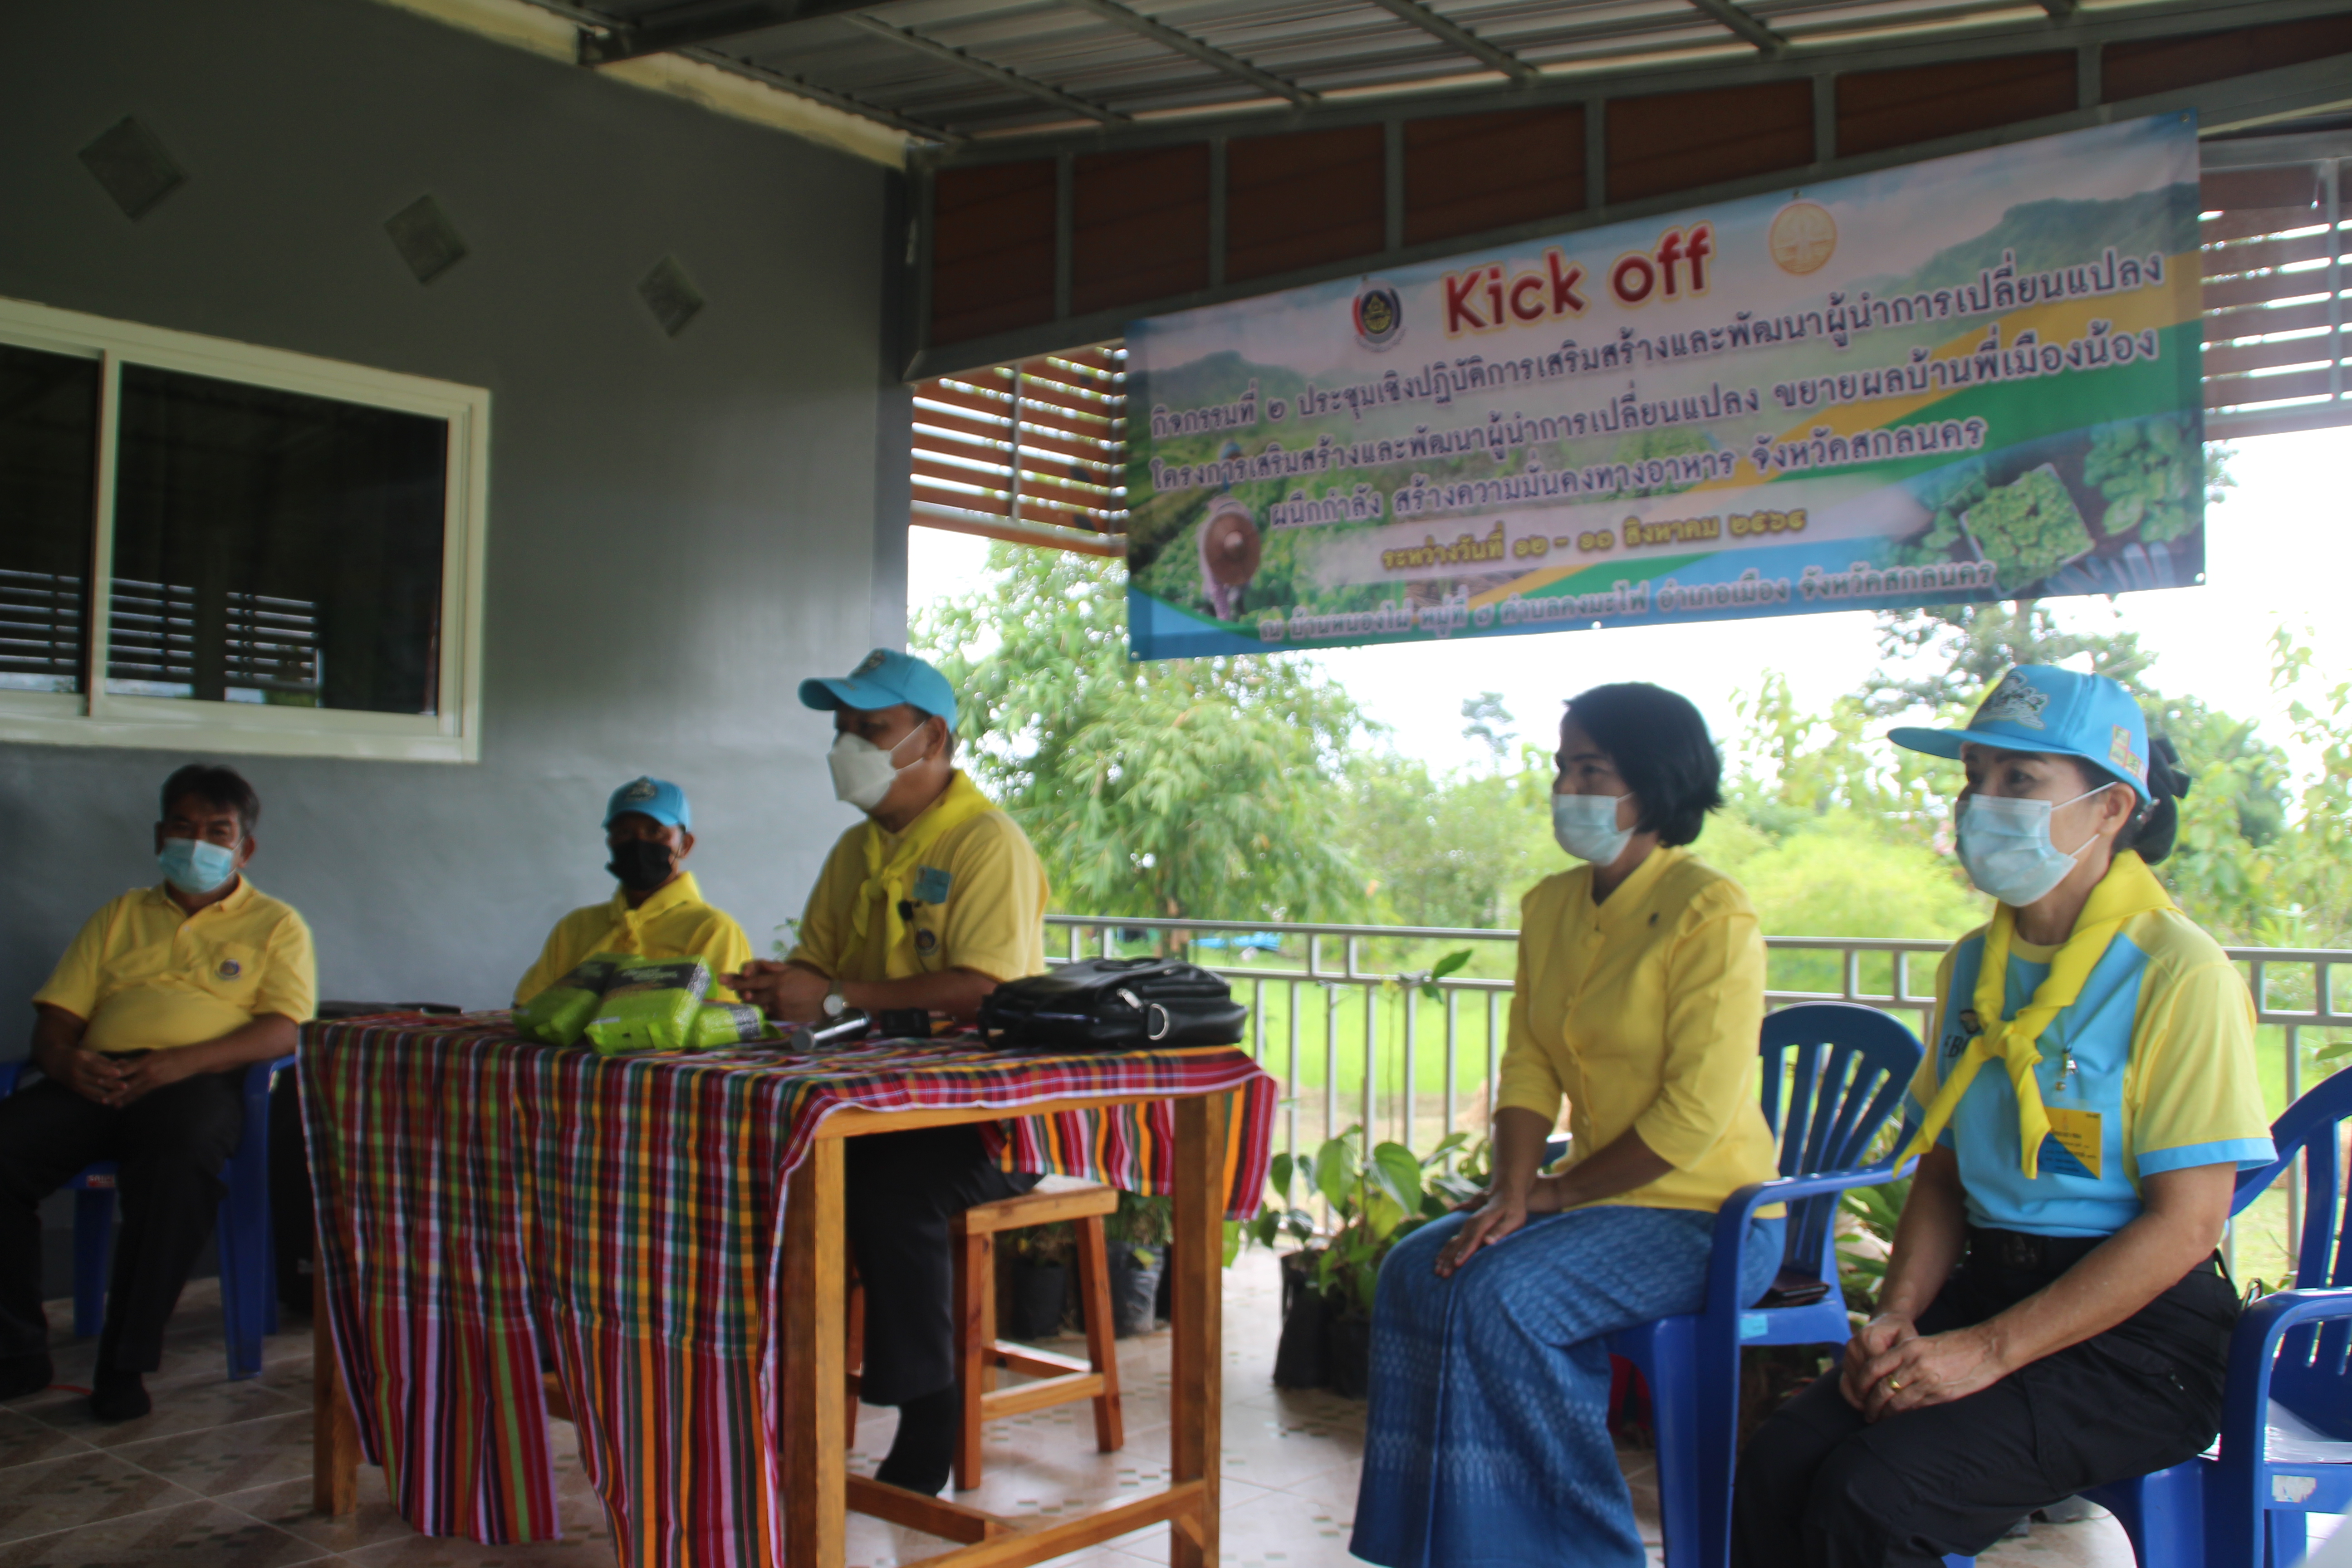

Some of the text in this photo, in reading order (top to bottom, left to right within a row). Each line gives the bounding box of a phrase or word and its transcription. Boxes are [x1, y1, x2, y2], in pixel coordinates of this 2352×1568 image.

[1446, 225, 1711, 334] Kick off
[1151, 320, 2157, 490] โครงการเสริมสร้างและพัฒนาผู้นำการเปลี่ยนแปลง ขยายผลบ้านพี่เมืองน้อง
[1152, 379, 1257, 436] กิจกรรมที่
[1271, 417, 1986, 526] ผนึกกำลัง สร้างความมั่นคงทางอาหาร จังหวัดสกลนคร
[1382, 521, 1504, 570] ระหว่างวันที่
[1624, 517, 1719, 547] สิงหาคม
[1660, 570, 1788, 609] อำเภอเมือง
[1802, 562, 1994, 598] จังหวัดสกลนคร
